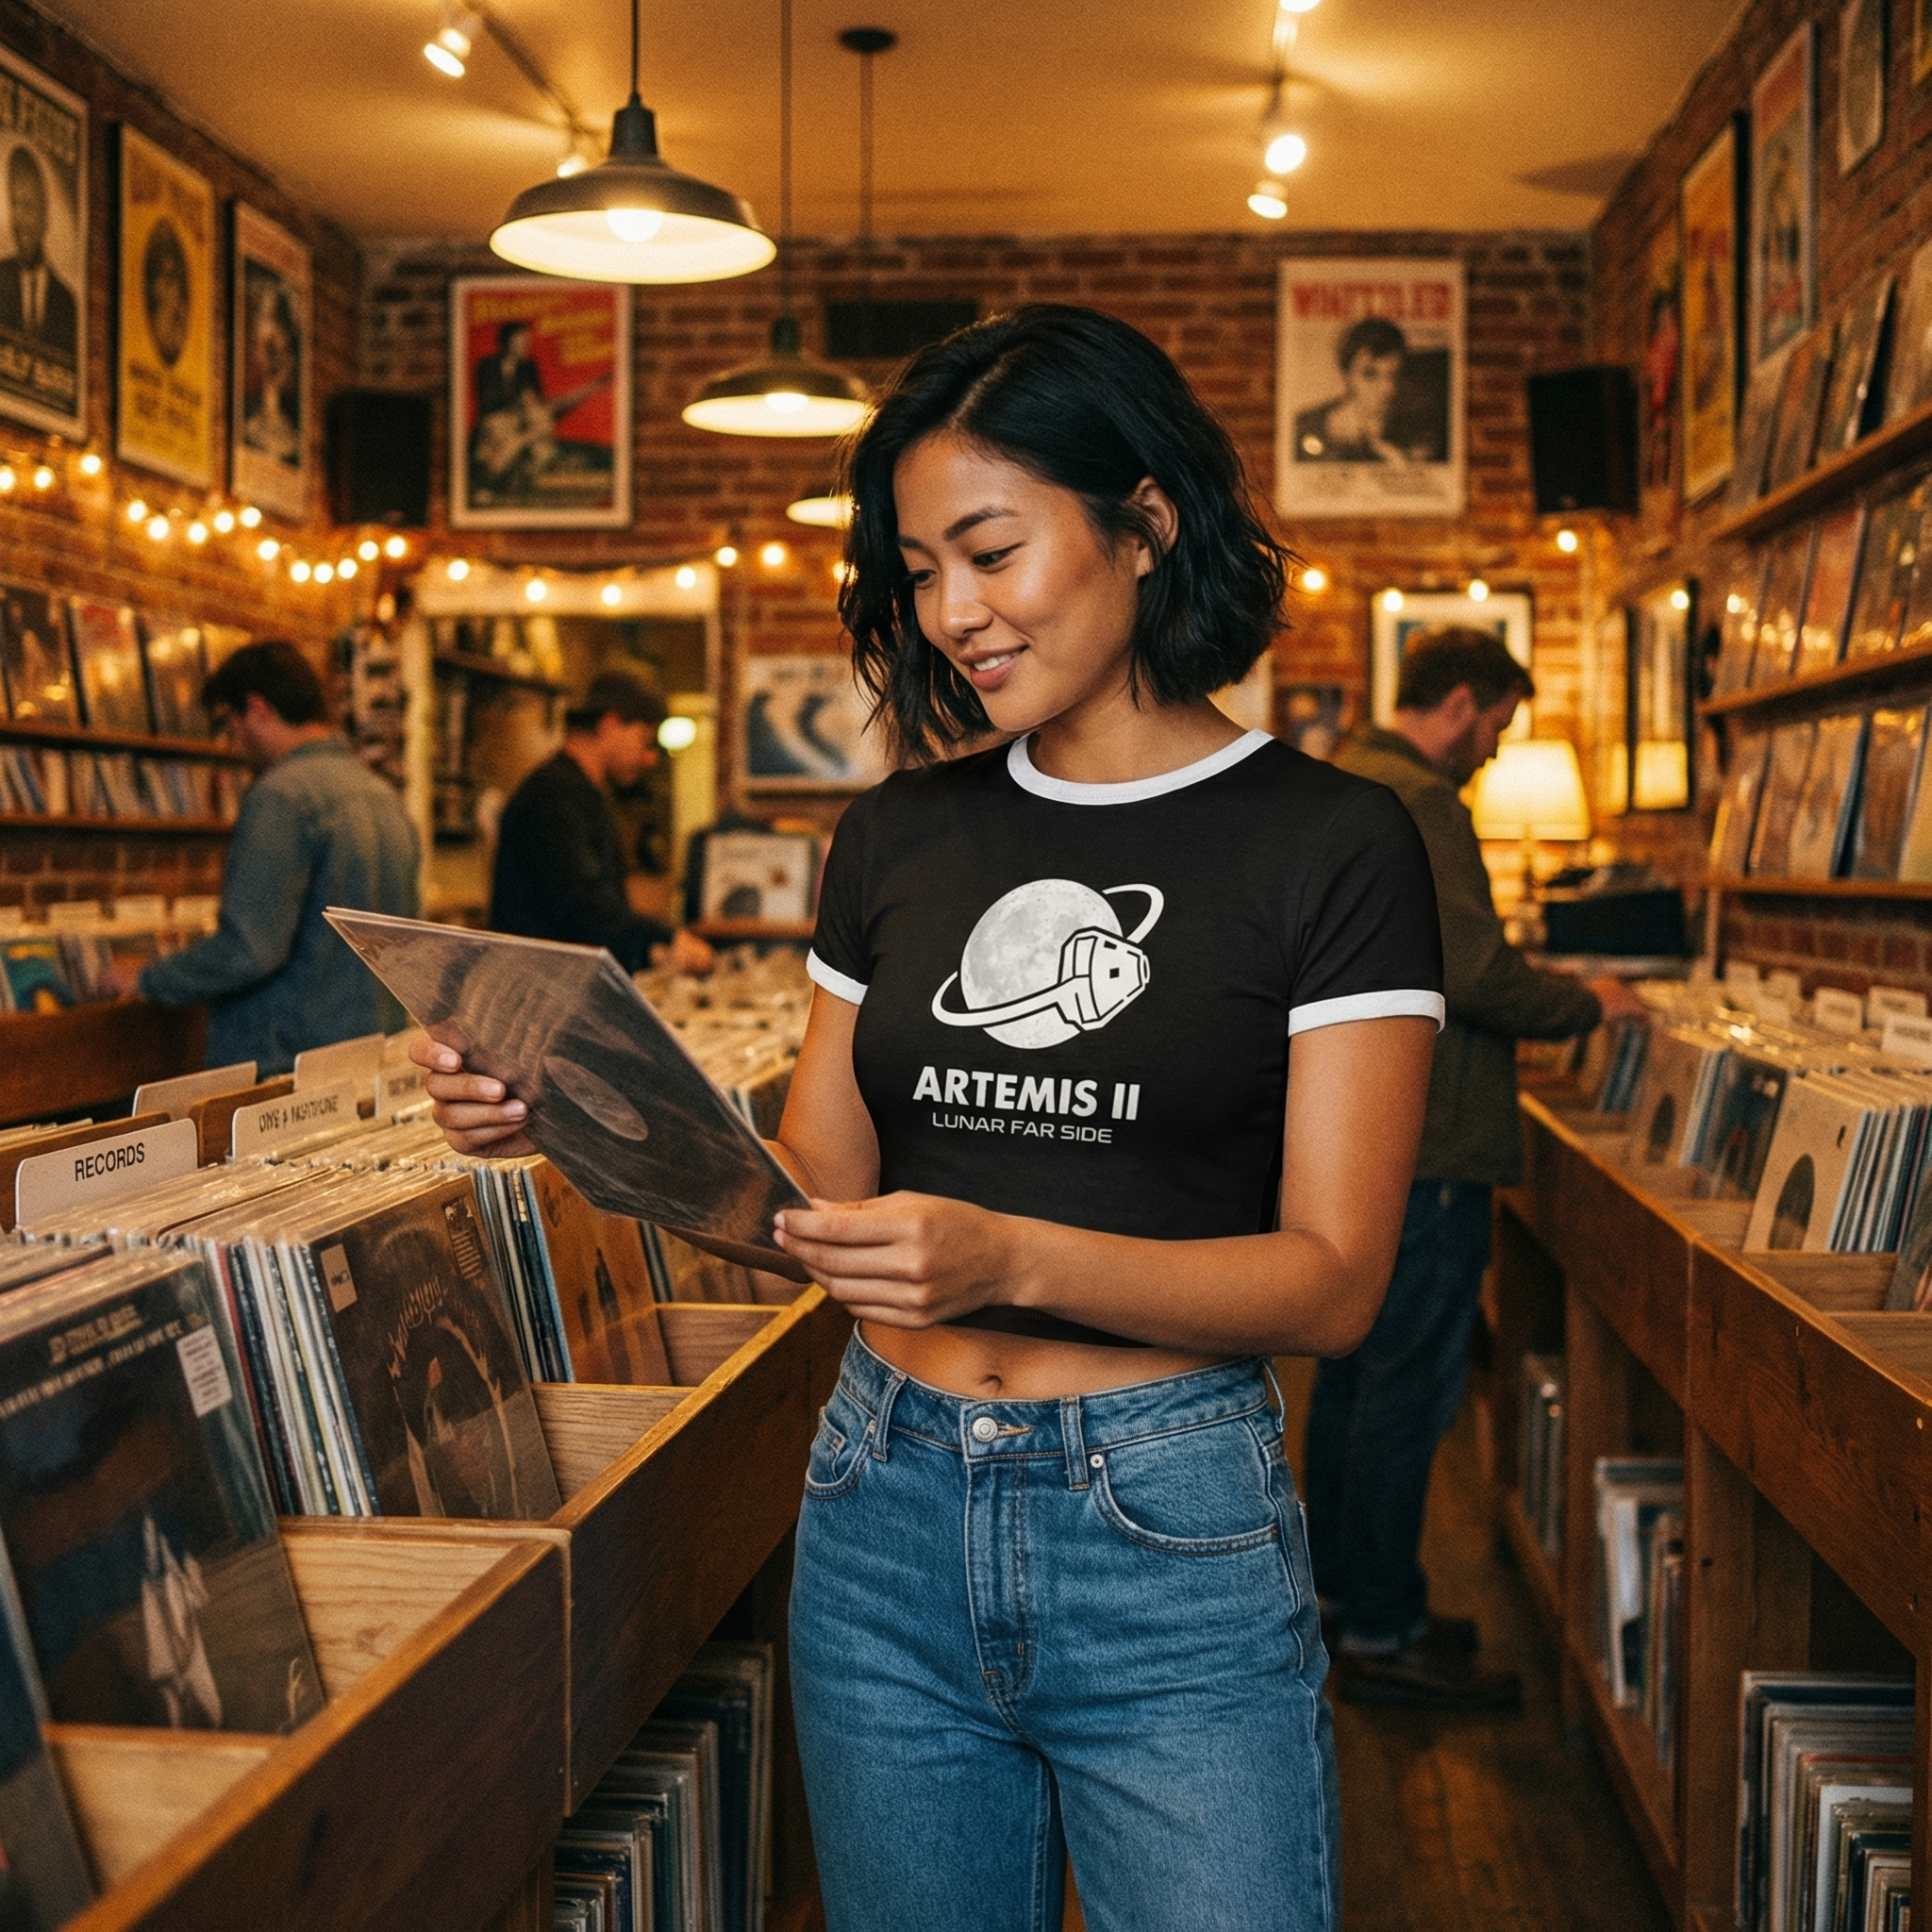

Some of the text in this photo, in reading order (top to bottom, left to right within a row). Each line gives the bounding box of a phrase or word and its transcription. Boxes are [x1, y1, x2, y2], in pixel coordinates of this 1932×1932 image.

[912, 1066, 1141, 1121] ARTEMIS II
[932, 1112, 1113, 1144] LUNAR FAR SIDE
[75, 1141, 145, 1182] RECORDS
